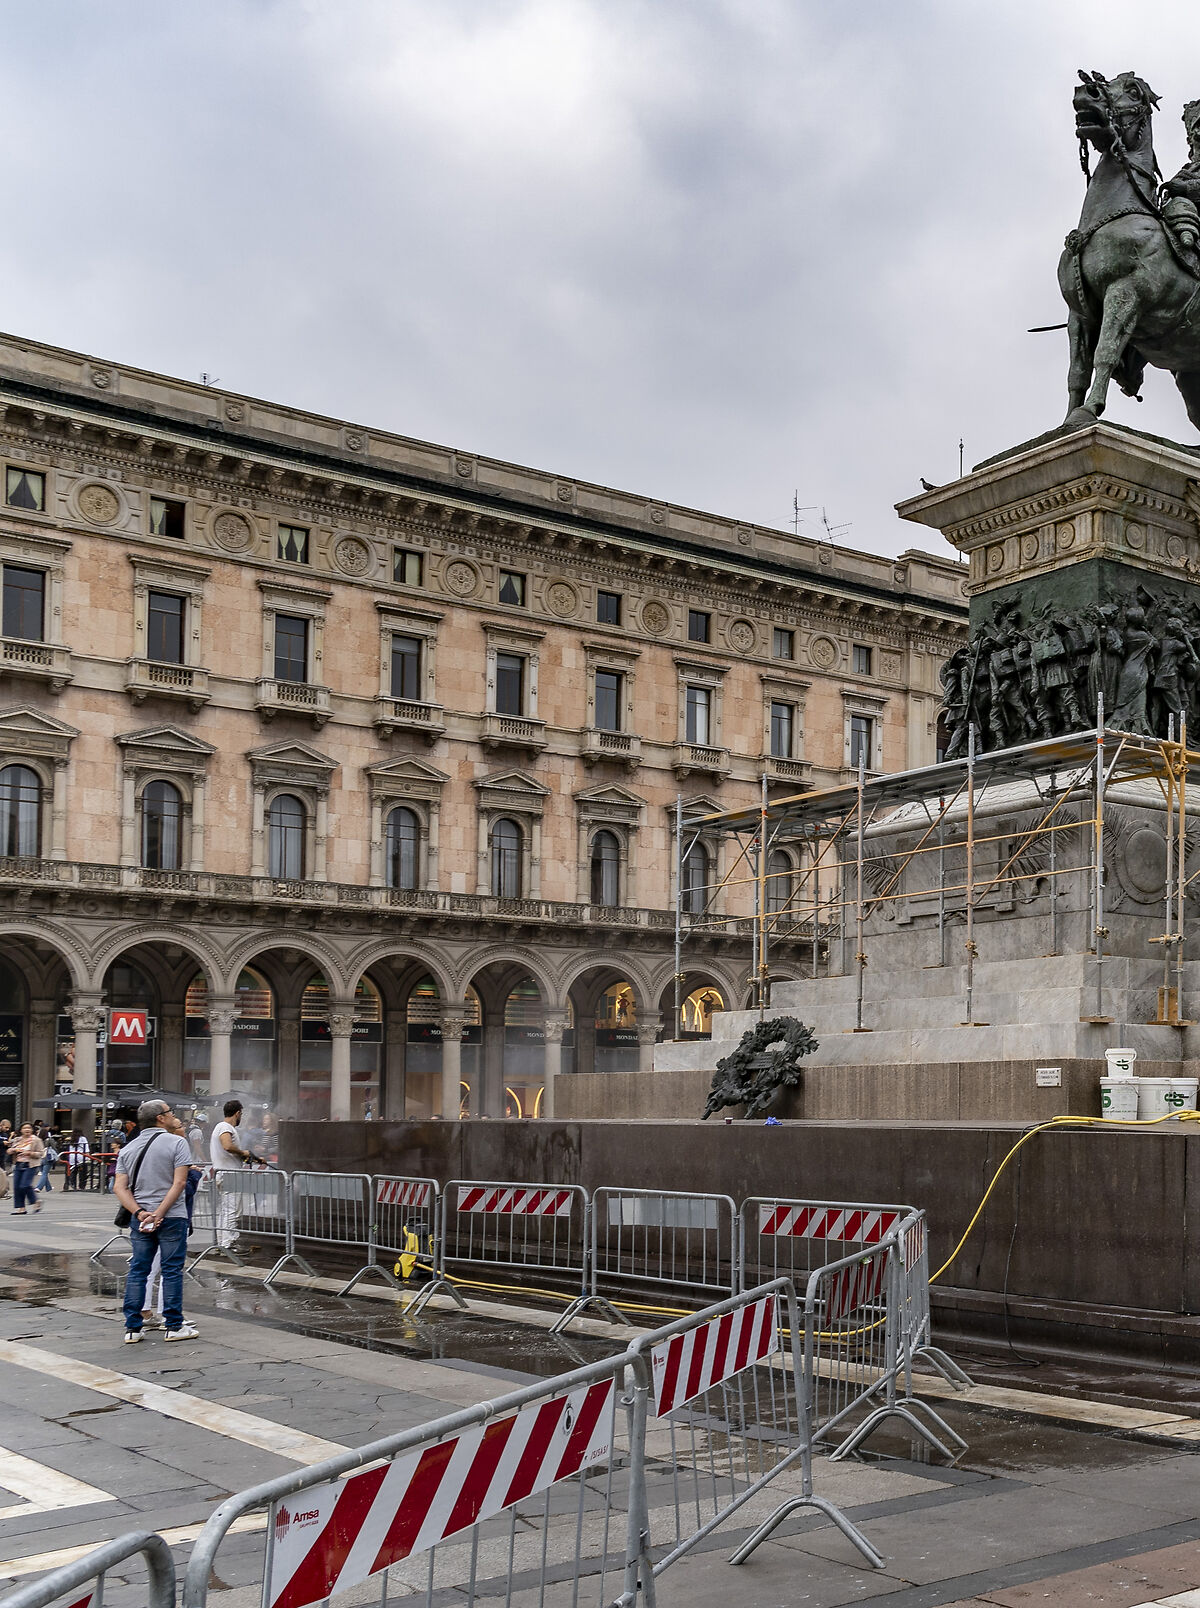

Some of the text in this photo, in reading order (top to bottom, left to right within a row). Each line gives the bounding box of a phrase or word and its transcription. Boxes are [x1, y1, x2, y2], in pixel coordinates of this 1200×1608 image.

[112, 1017, 144, 1038] M
[62, 1086, 72, 1094] 12
[292, 1509, 319, 1524] Amsa
